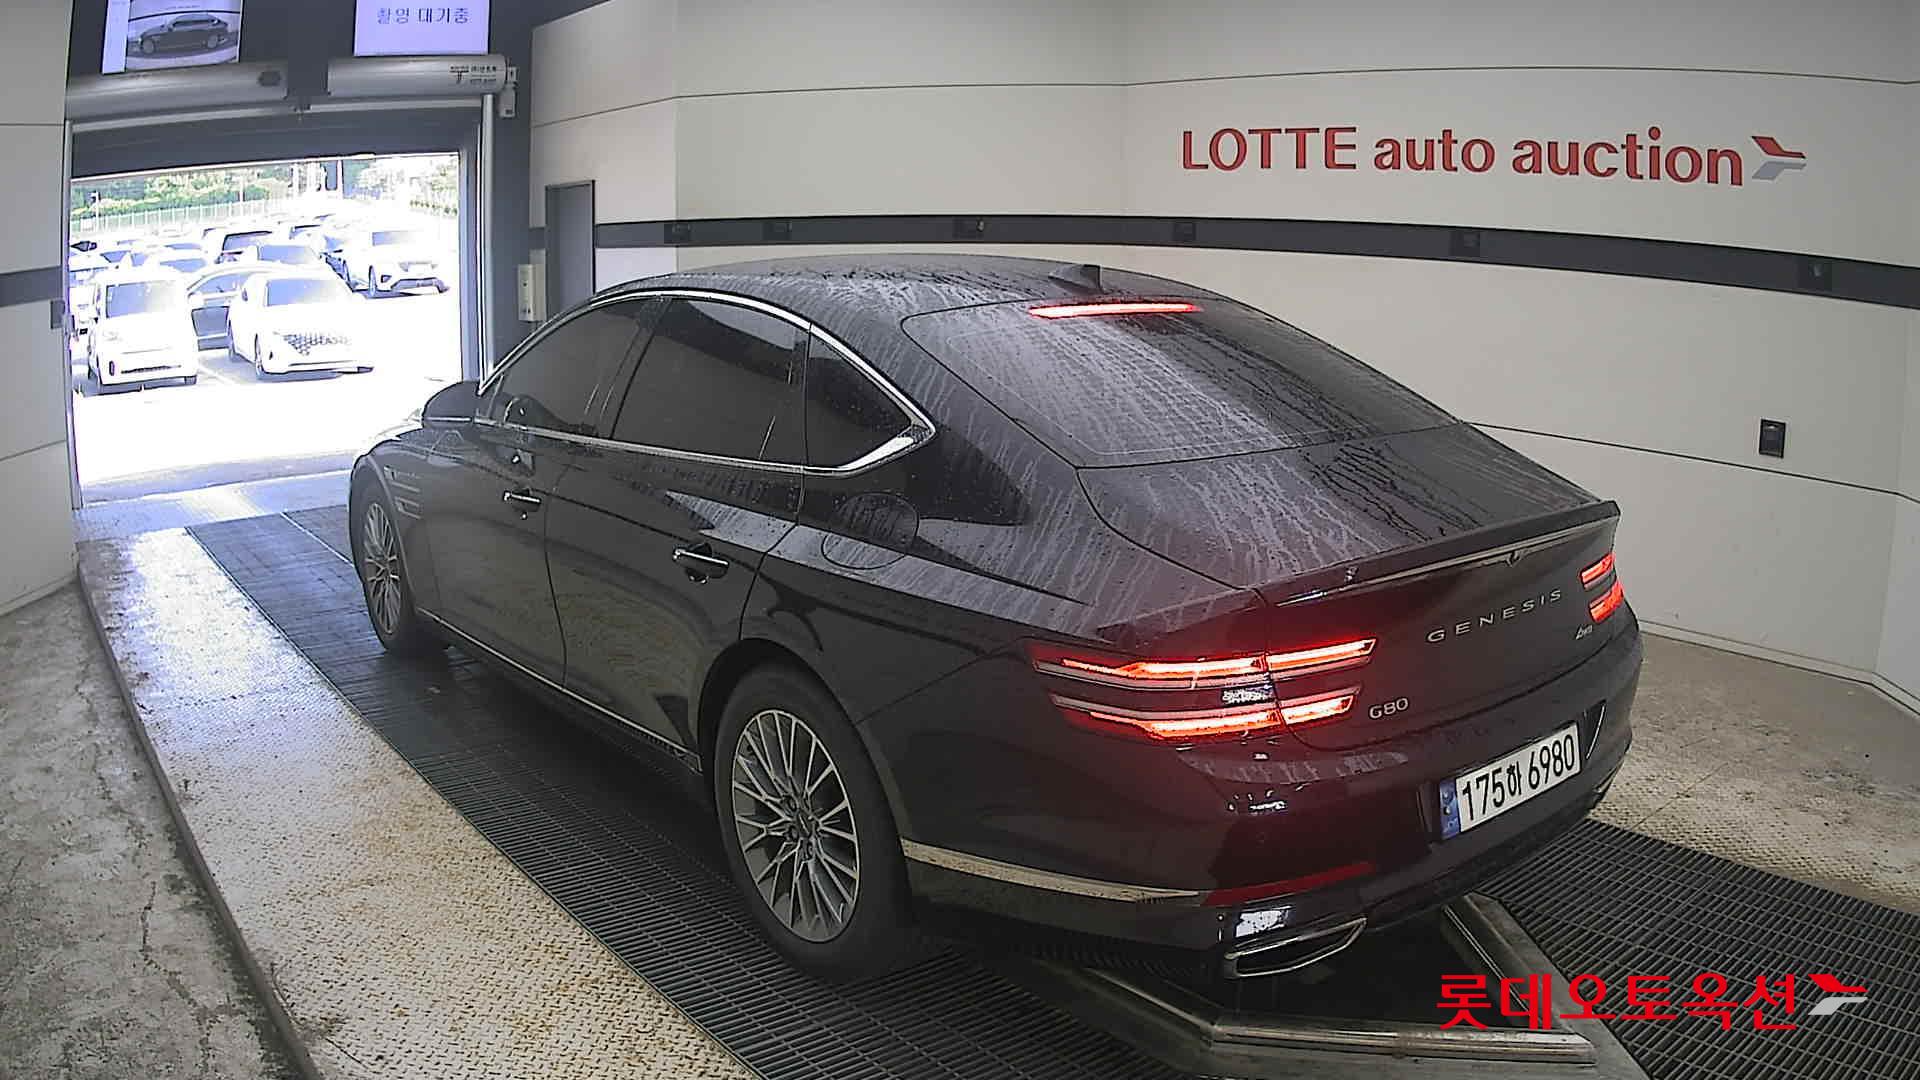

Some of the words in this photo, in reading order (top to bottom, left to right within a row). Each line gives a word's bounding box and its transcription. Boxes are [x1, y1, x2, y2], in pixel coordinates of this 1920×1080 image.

[418, 7, 469, 24] 대기중
[1183, 127, 1357, 170] LOTTE
[1373, 129, 1496, 173] auto
[1511, 126, 1744, 186] auction
[1427, 589, 1561, 642] GENESIS
[1369, 697, 1409, 720] G80
[1462, 761, 1522, 821] 175하
[1528, 734, 1575, 790] 6980
